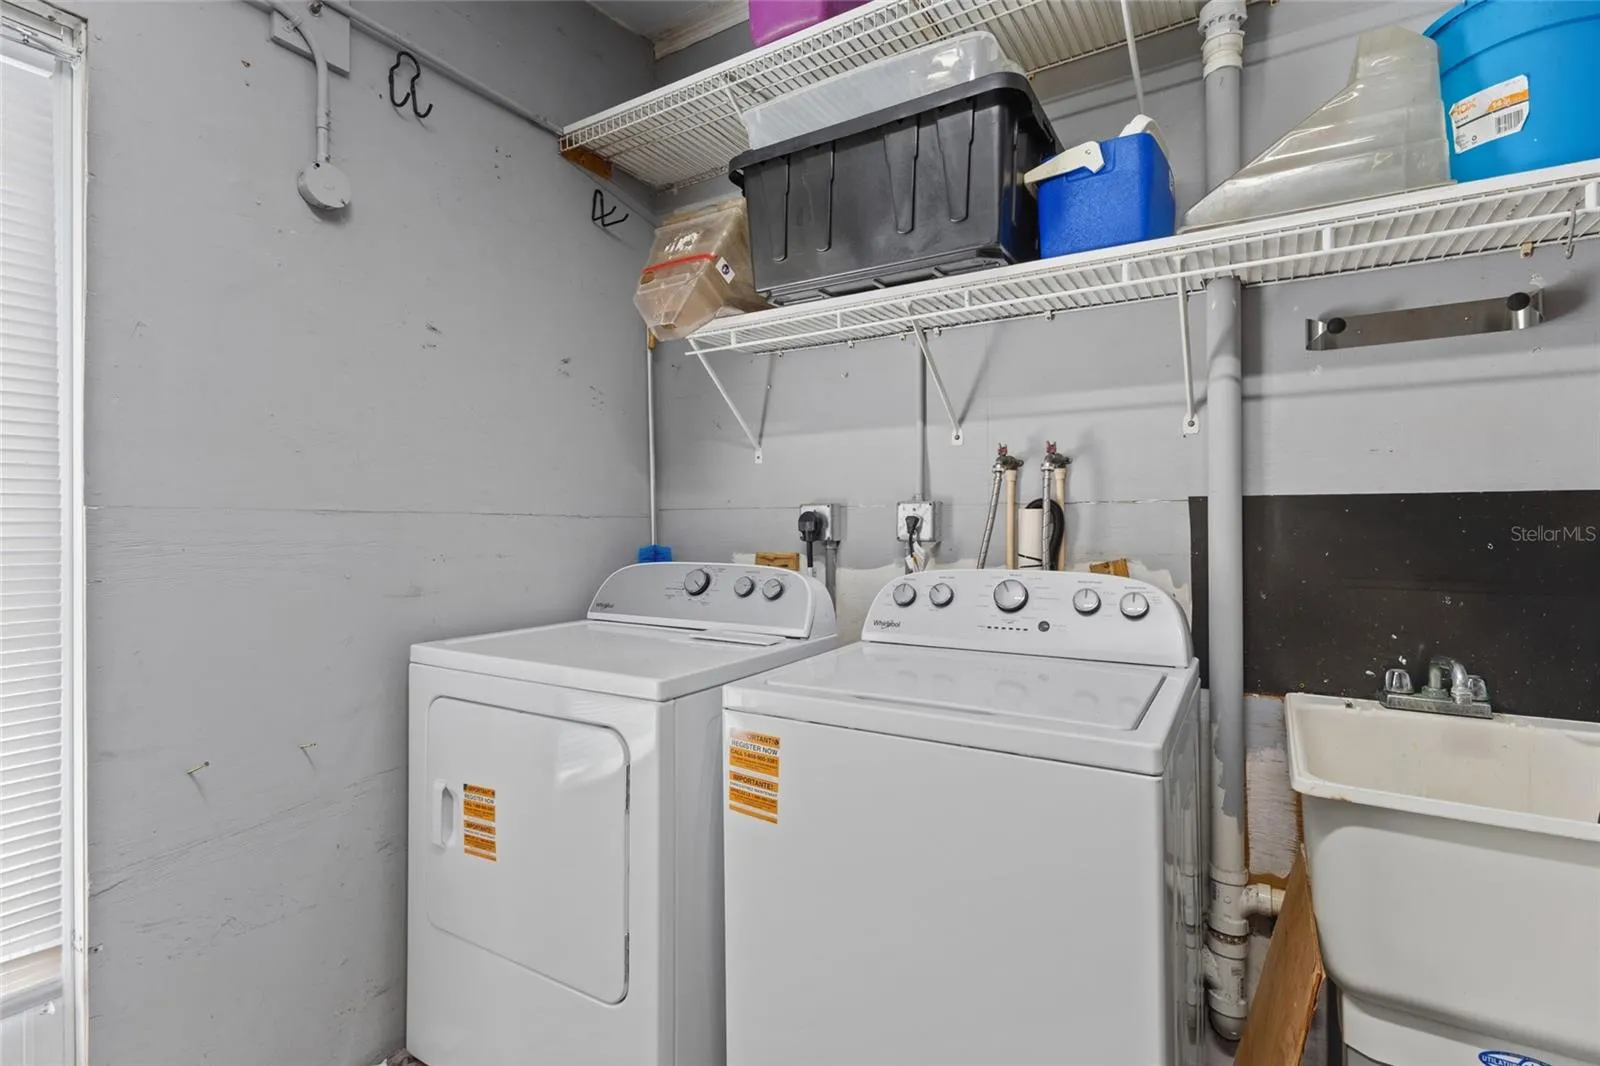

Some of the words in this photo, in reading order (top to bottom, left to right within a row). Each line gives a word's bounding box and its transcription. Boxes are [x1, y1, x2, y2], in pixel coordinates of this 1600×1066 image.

[873, 619, 900, 629] Whirlpool
[732, 740, 762, 752] REGISTER
[762, 746, 778, 756] NOW
